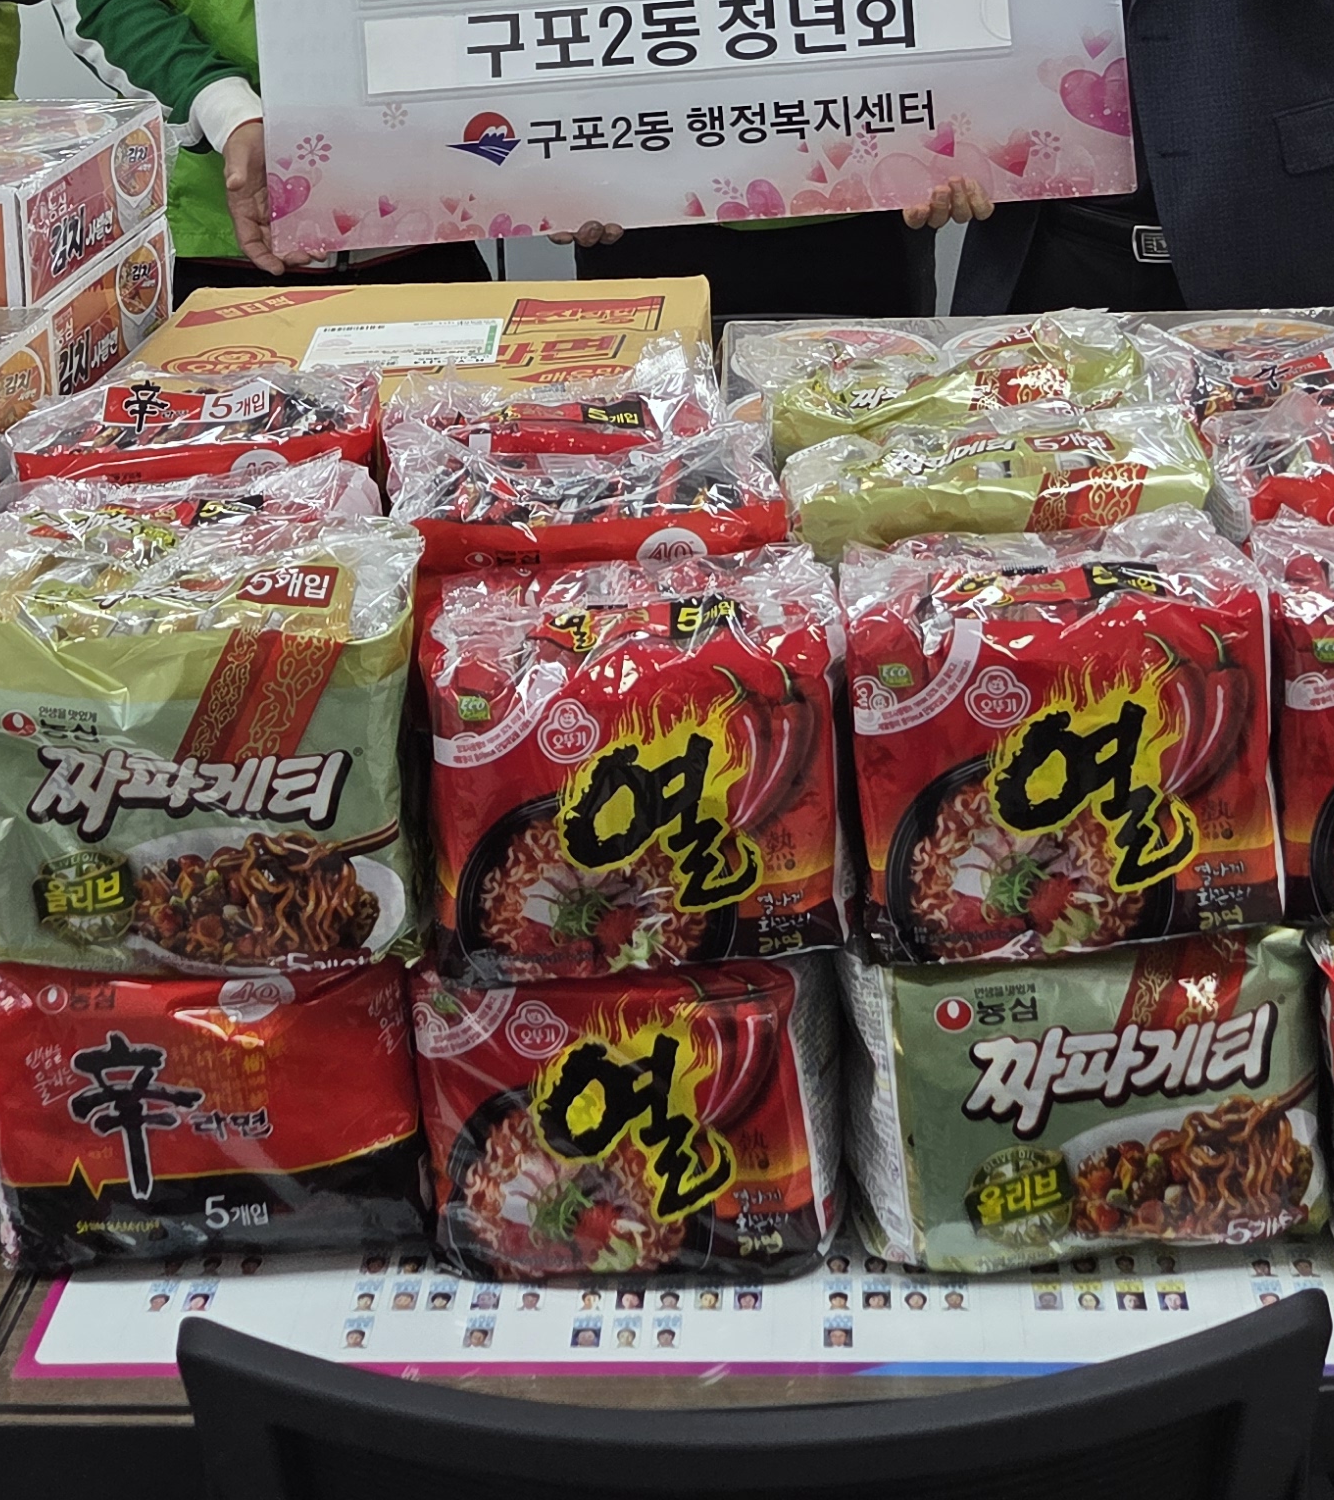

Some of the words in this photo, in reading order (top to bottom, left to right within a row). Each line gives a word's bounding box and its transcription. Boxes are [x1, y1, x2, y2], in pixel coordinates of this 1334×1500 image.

[526, 110, 675, 162] 구포2동
[686, 88, 938, 152] 행정복지센터
[127, 145, 149, 164] 김치
[49, 204, 86, 279] 김치
[131, 261, 152, 281] 김치
[3, 369, 32, 395] 김치
[124, 380, 169, 436] 辛
[208, 390, 268, 420] 5개입
[586, 407, 639, 426] 5개입
[244, 565, 331, 599] 5개입
[882, 666, 907, 678] ECO
[979, 699, 1017, 716] 오뚜기
[552, 732, 587, 751] 오뚜기
[27, 745, 352, 843] 짜파게티
[994, 699, 1198, 891] 열
[567, 732, 762, 909] 열
[43, 868, 125, 913] 올리브
[758, 930, 803, 954] 라면
[975, 996, 1039, 1026] 농심
[520, 1028, 556, 1047] 오뚜기
[961, 1001, 1278, 1140] 짜파게티
[67, 1030, 206, 1200] 辛
[188, 1109, 274, 1141] 라면
[536, 1033, 732, 1219] 열
[982, 1153, 1016, 1173] OLIVE
[1017, 1150, 1038, 1163] OIL
[204, 1194, 269, 1231] 5개입
[977, 1170, 1063, 1225] 올리브
